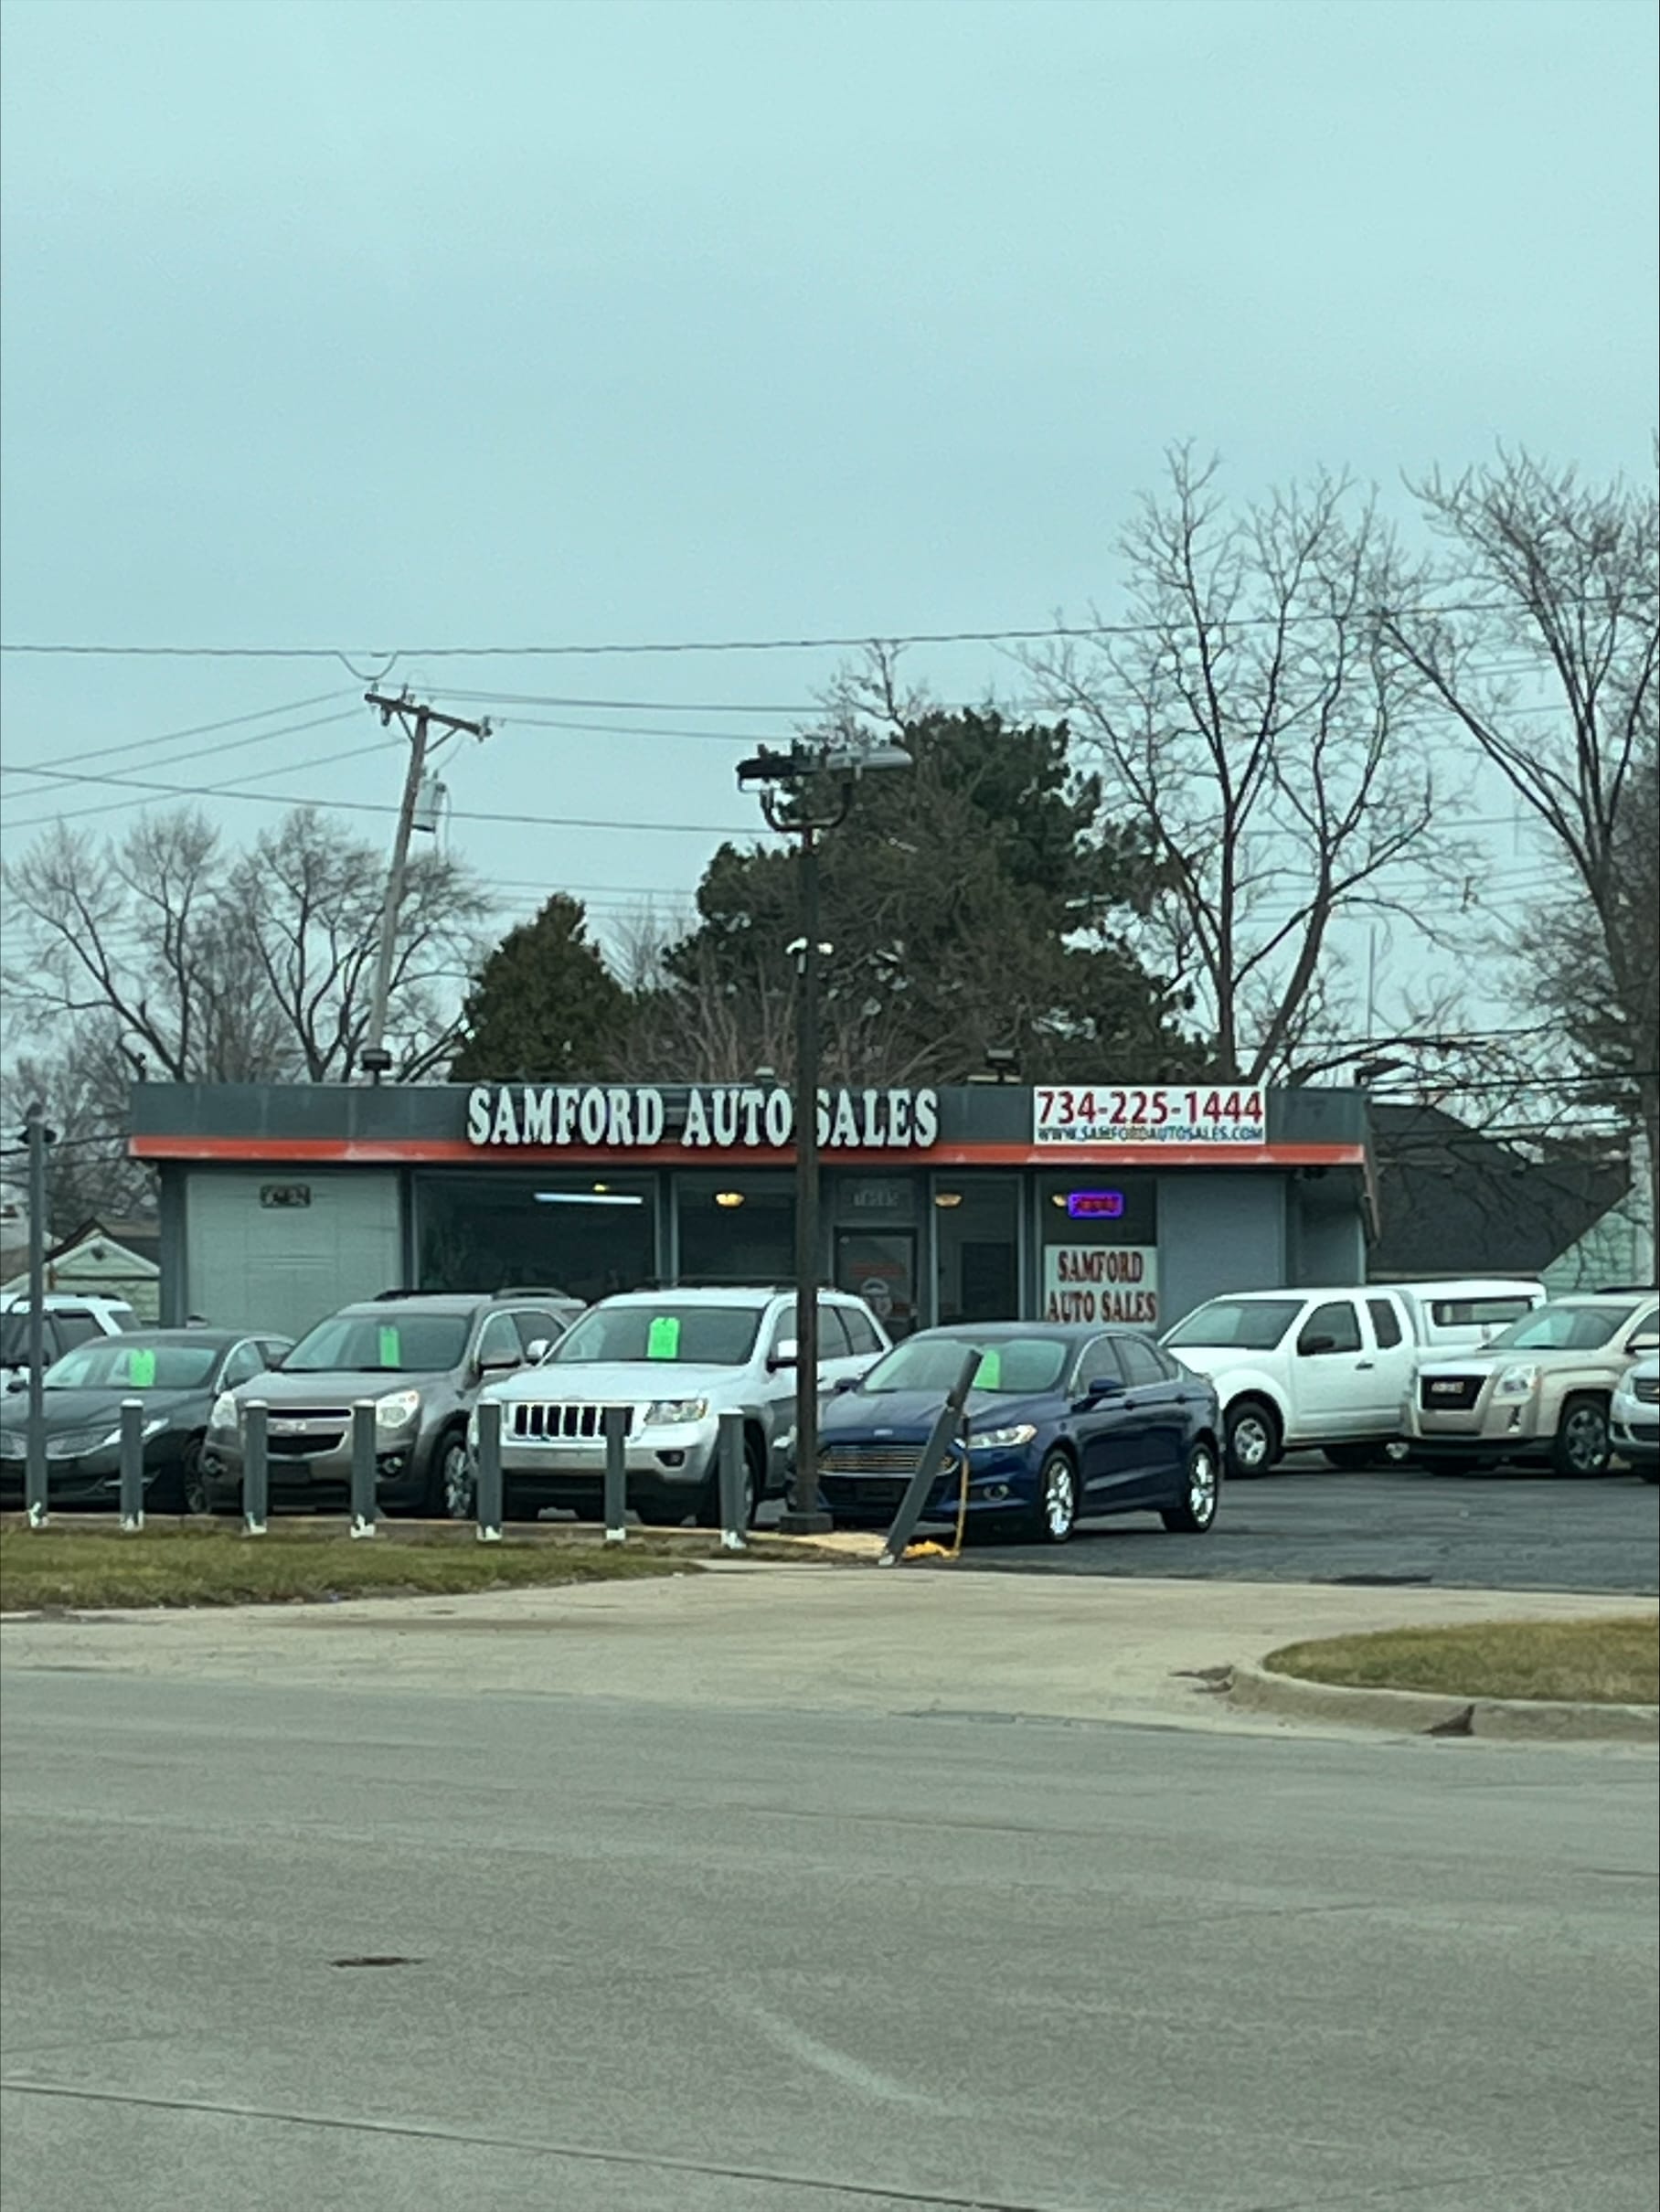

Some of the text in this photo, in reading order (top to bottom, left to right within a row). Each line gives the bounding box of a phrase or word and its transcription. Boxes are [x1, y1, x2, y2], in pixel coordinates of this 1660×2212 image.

[467, 1087, 665, 1146] SAMFORD
[681, 1087, 793, 1147] AUTO
[1037, 1090, 1263, 1124] 734-225-1444
[1038, 1125, 1263, 1142] WWW.SAMFORDAUTOSALES.COM
[1058, 1250, 1144, 1284] SAMFORD
[1048, 1290, 1157, 1324] AUTO SALES
